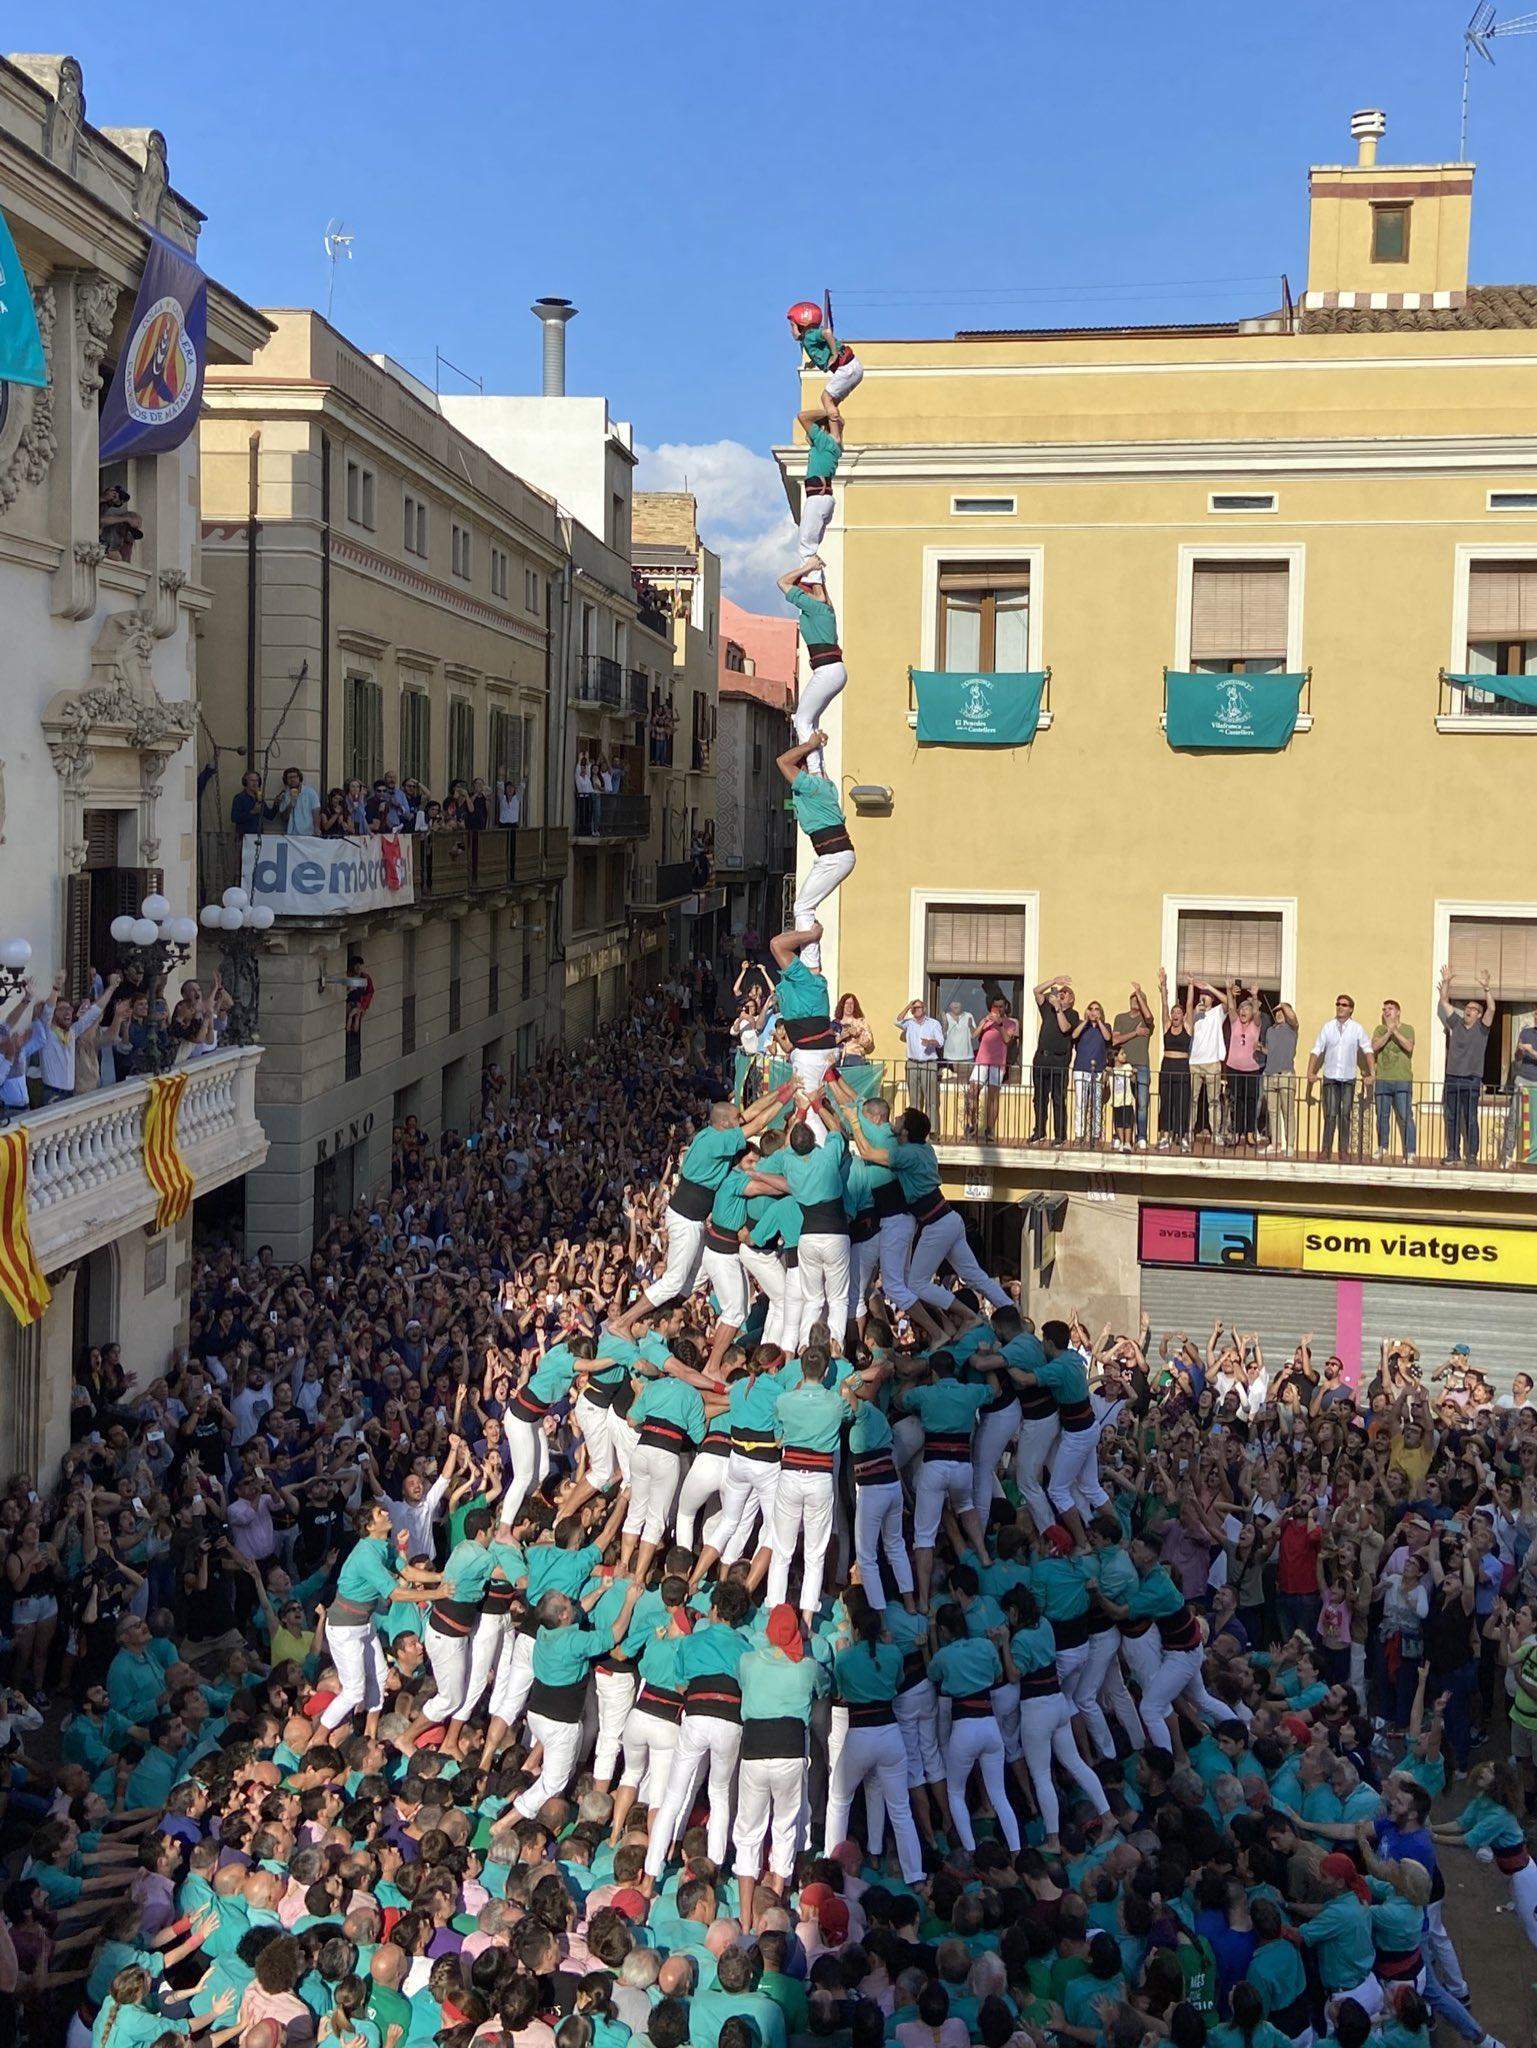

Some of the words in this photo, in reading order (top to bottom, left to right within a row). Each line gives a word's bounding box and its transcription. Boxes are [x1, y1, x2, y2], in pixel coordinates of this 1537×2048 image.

[317, 1112, 374, 1163] RENO
[1159, 1229, 1195, 1239] avasa
[1221, 1233, 1257, 1265] a
[1305, 1233, 1371, 1254] som
[1380, 1234, 1499, 1265] viatges
